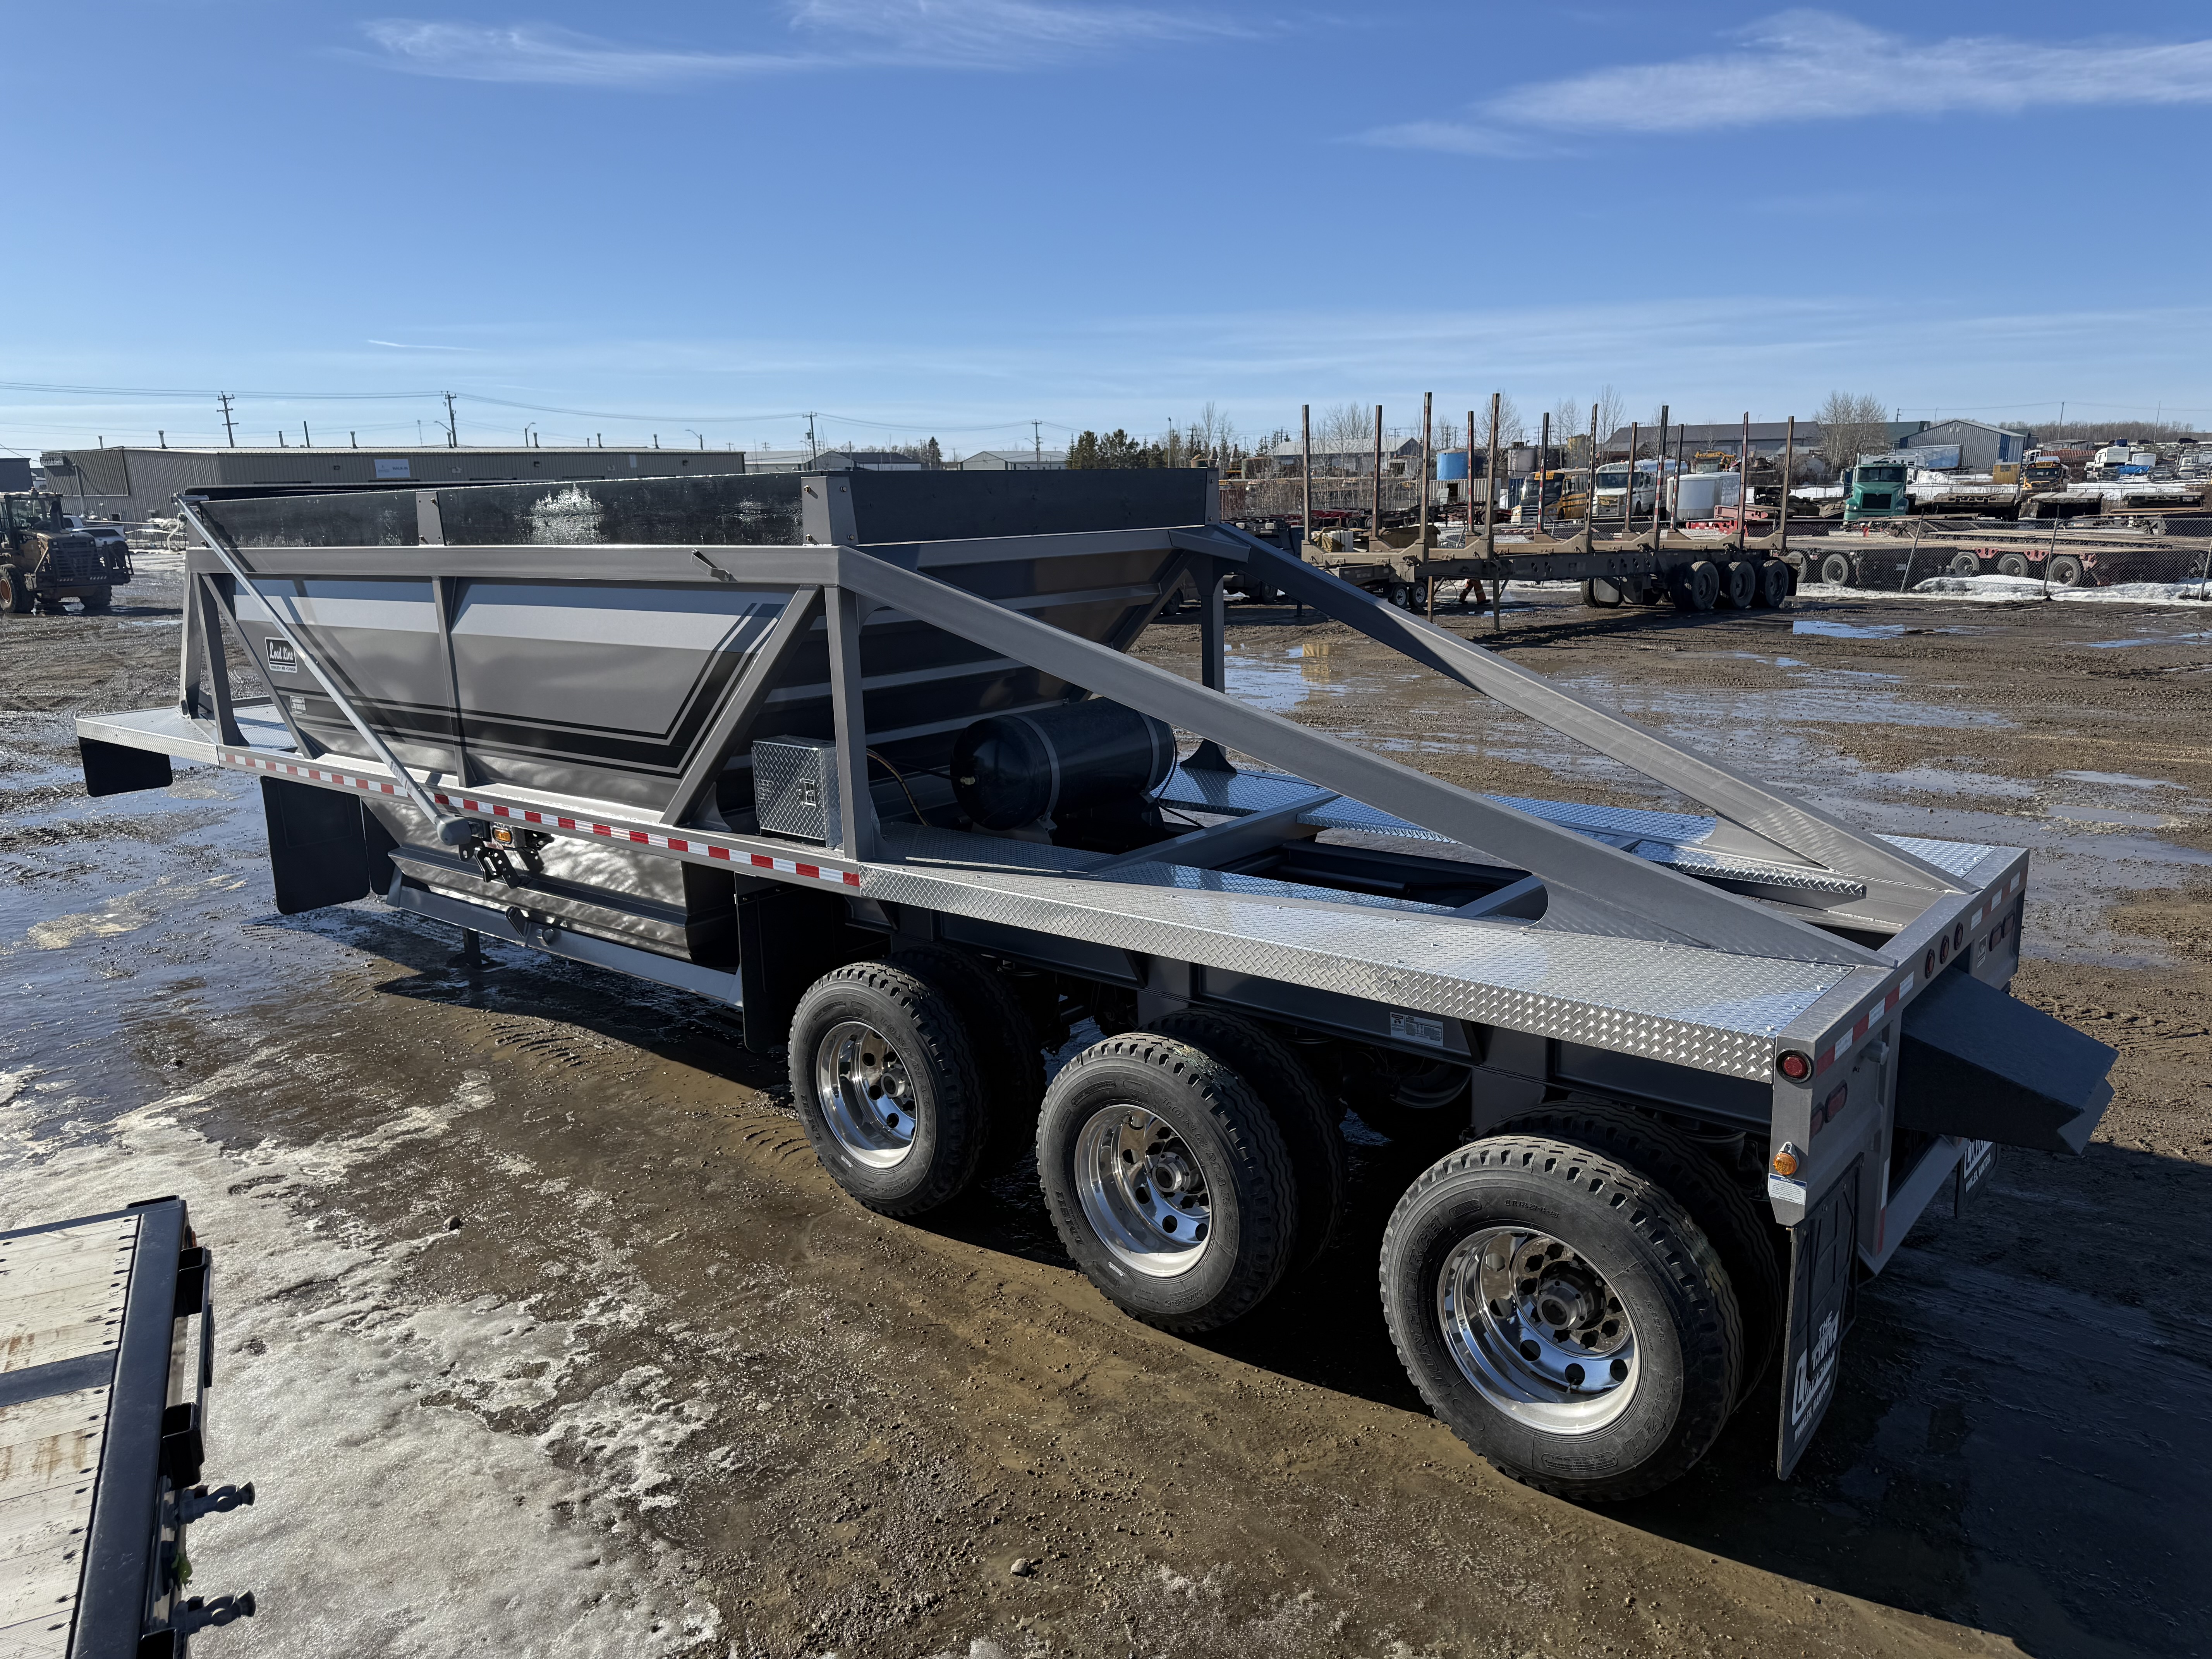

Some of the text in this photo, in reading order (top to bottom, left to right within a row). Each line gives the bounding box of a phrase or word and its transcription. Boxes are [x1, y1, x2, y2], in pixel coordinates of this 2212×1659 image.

[270, 641, 293, 661] Load Line
[1404, 1214, 1451, 1396] LONGMARCH
[1819, 1310, 1832, 1340] THE
